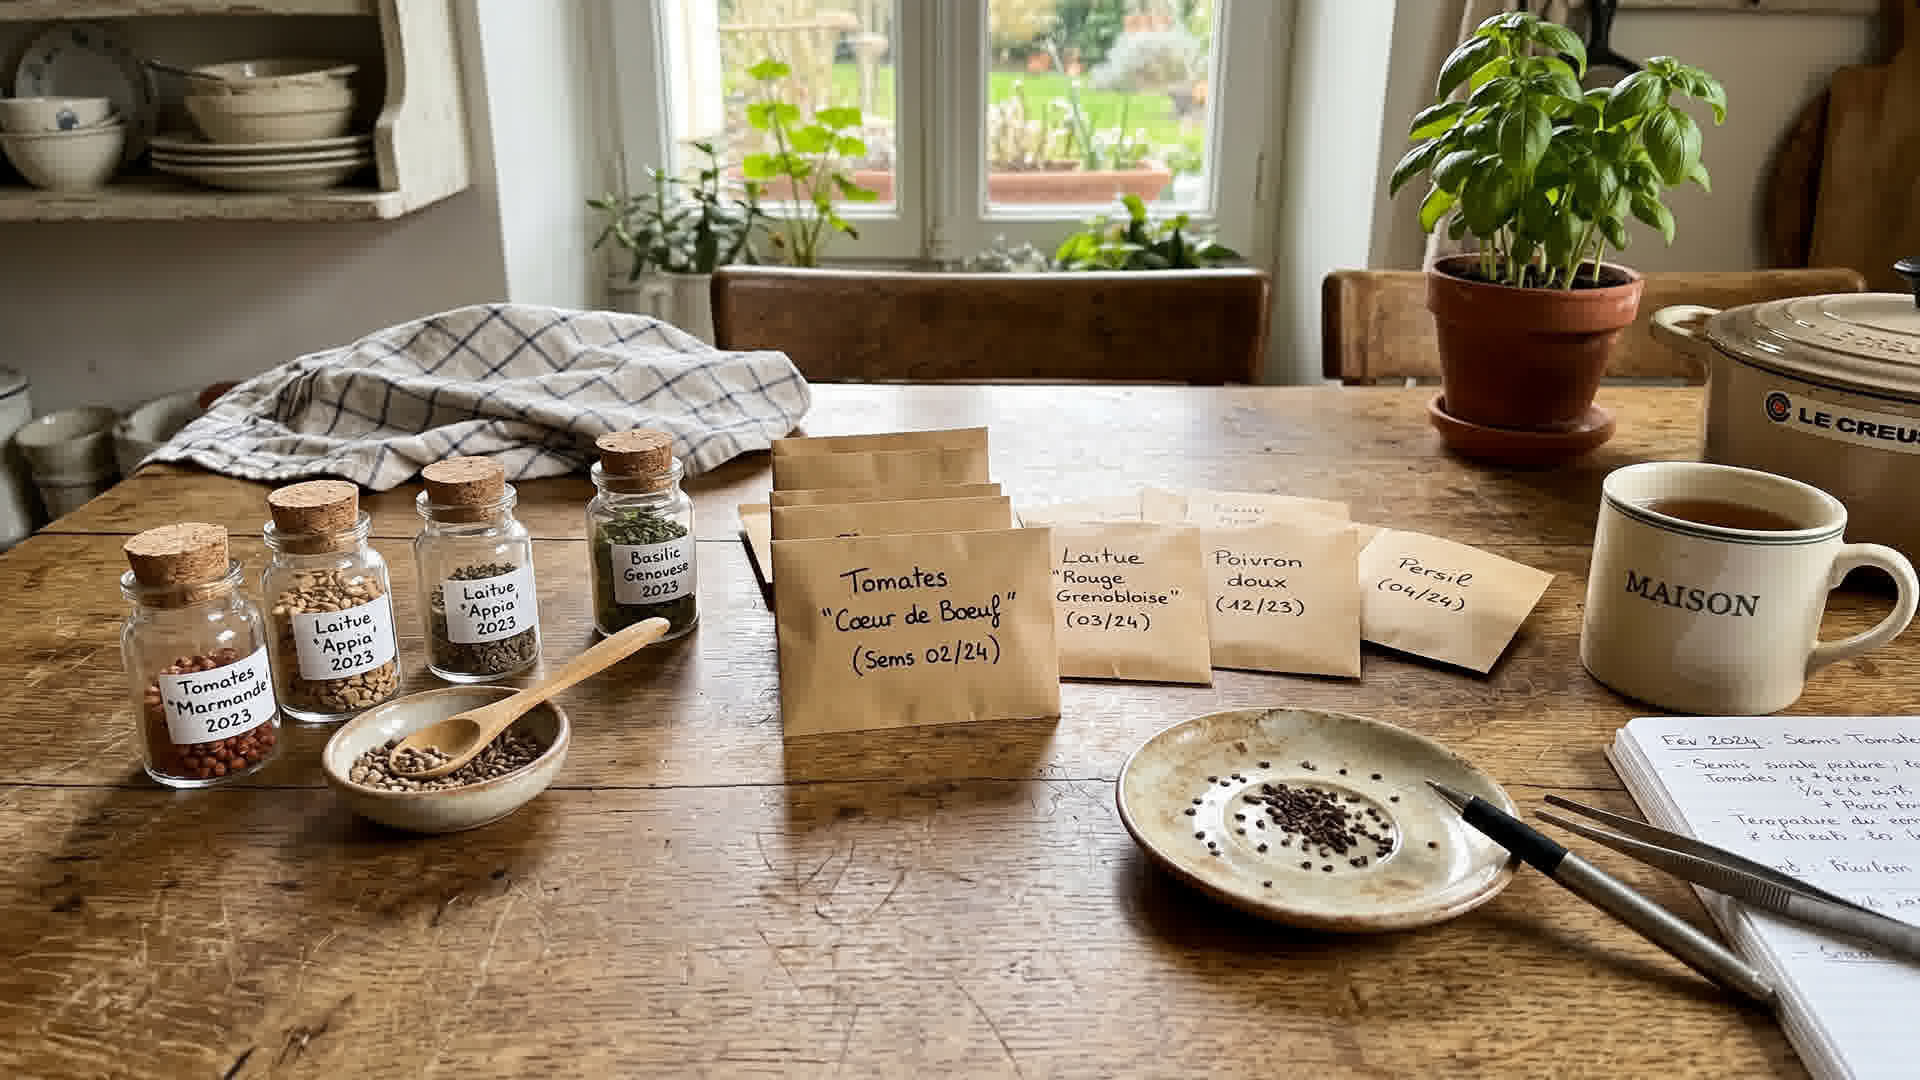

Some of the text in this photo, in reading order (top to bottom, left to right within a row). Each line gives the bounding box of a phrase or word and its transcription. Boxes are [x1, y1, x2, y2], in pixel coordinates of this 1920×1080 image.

[1799, 408, 1920, 443] LE CREU
[631, 547, 681, 565] Basilic
[1062, 546, 1144, 565] Laitue
[1214, 550, 1303, 568] Poivron
[623, 562, 689, 582] Genovese
[840, 566, 948, 593] Tomates
[1052, 568, 1125, 590] "Rouge
[1227, 574, 1288, 589] doux
[1399, 557, 1473, 587] Persil
[464, 583, 515, 600] Laitue
[642, 580, 678, 597] 2023
[1056, 588, 1179, 605] Grenobloise"
[1377, 578, 1464, 611] (04/24)
[1625, 569, 1760, 617] MAISON
[905, 603, 931, 624] de
[1215, 596, 1304, 616] (12/23)
[315, 614, 371, 634] Laitue
[477, 615, 516, 635] 2023
[1066, 611, 1150, 632] (03/24)
[331, 650, 374, 671] 2023
[853, 634, 1000, 677] (Sems 02/24)
[177, 667, 255, 695] Tomates
[206, 708, 252, 732] 2023
[1783, 733, 1840, 745] Semis
